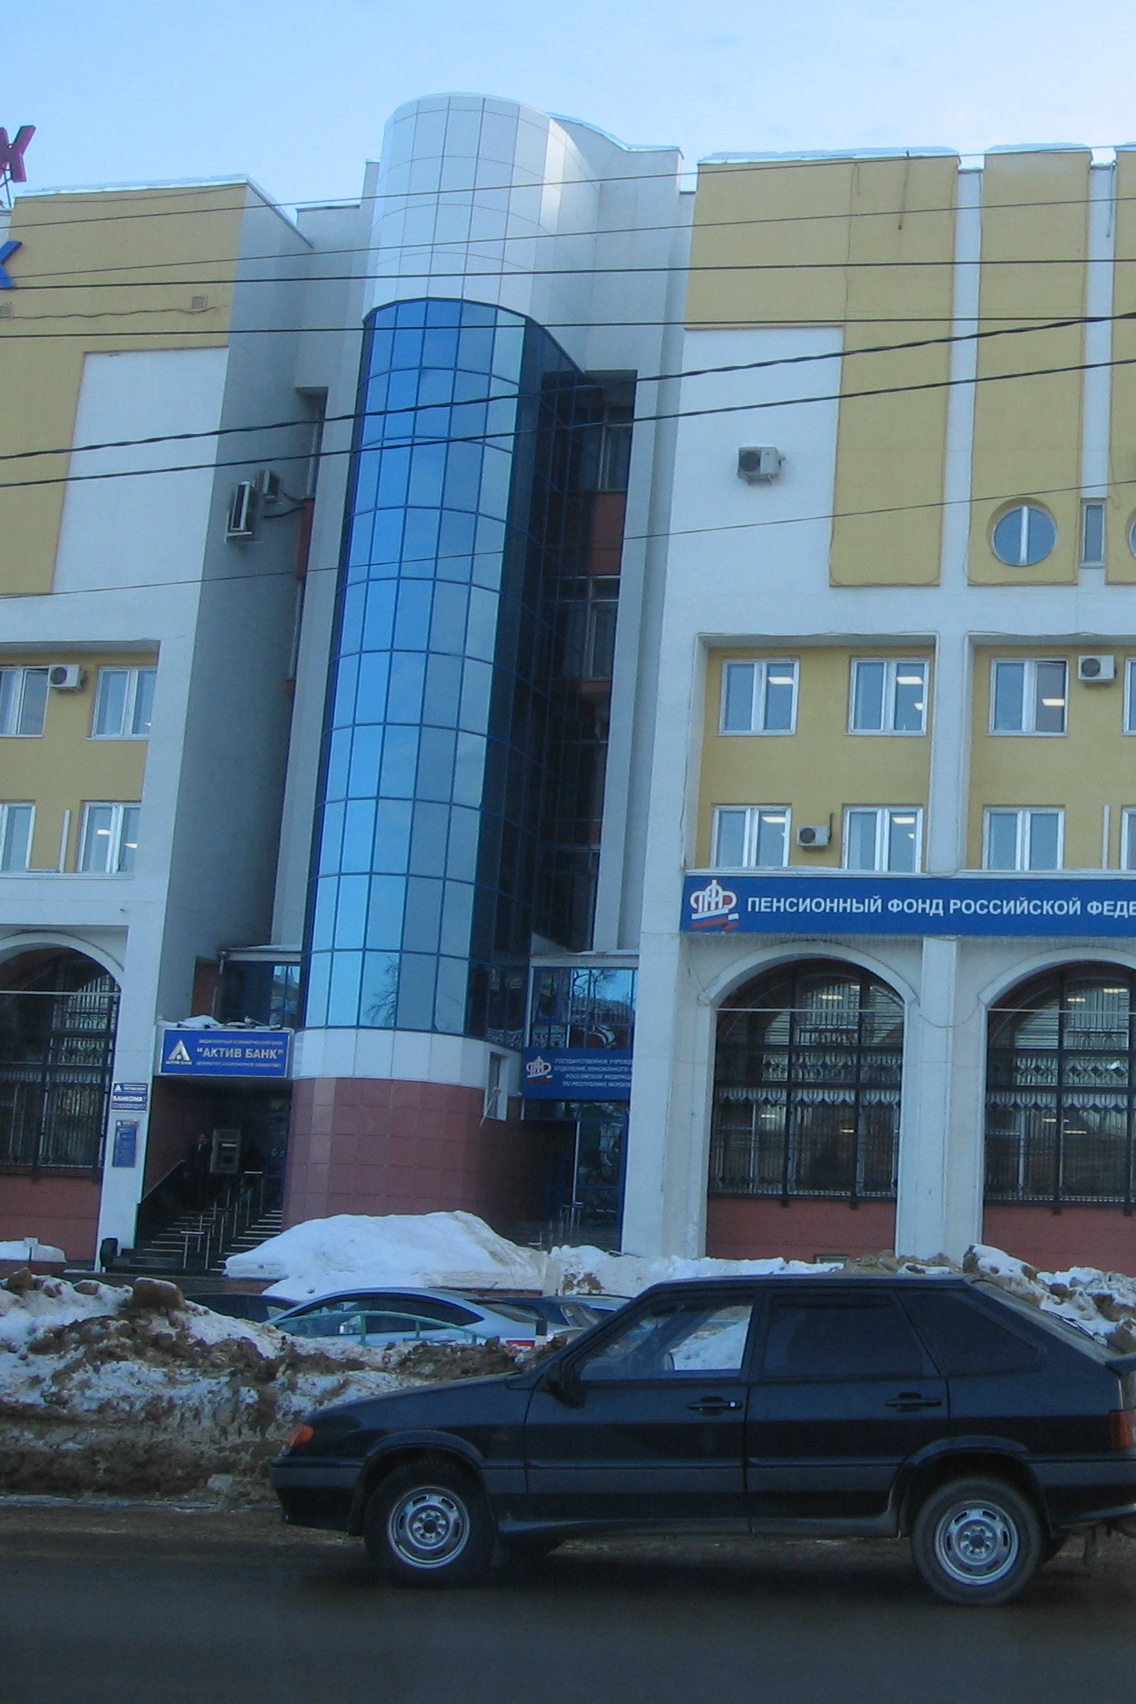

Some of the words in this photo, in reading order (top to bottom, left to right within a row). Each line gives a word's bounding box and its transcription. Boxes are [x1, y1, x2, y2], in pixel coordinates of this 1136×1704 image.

[747, 895, 882, 914] ПЕНСИОННЫЙ
[888, 898, 944, 917] ФОНД
[949, 896, 1081, 916] РОССИЙСКОЙ
